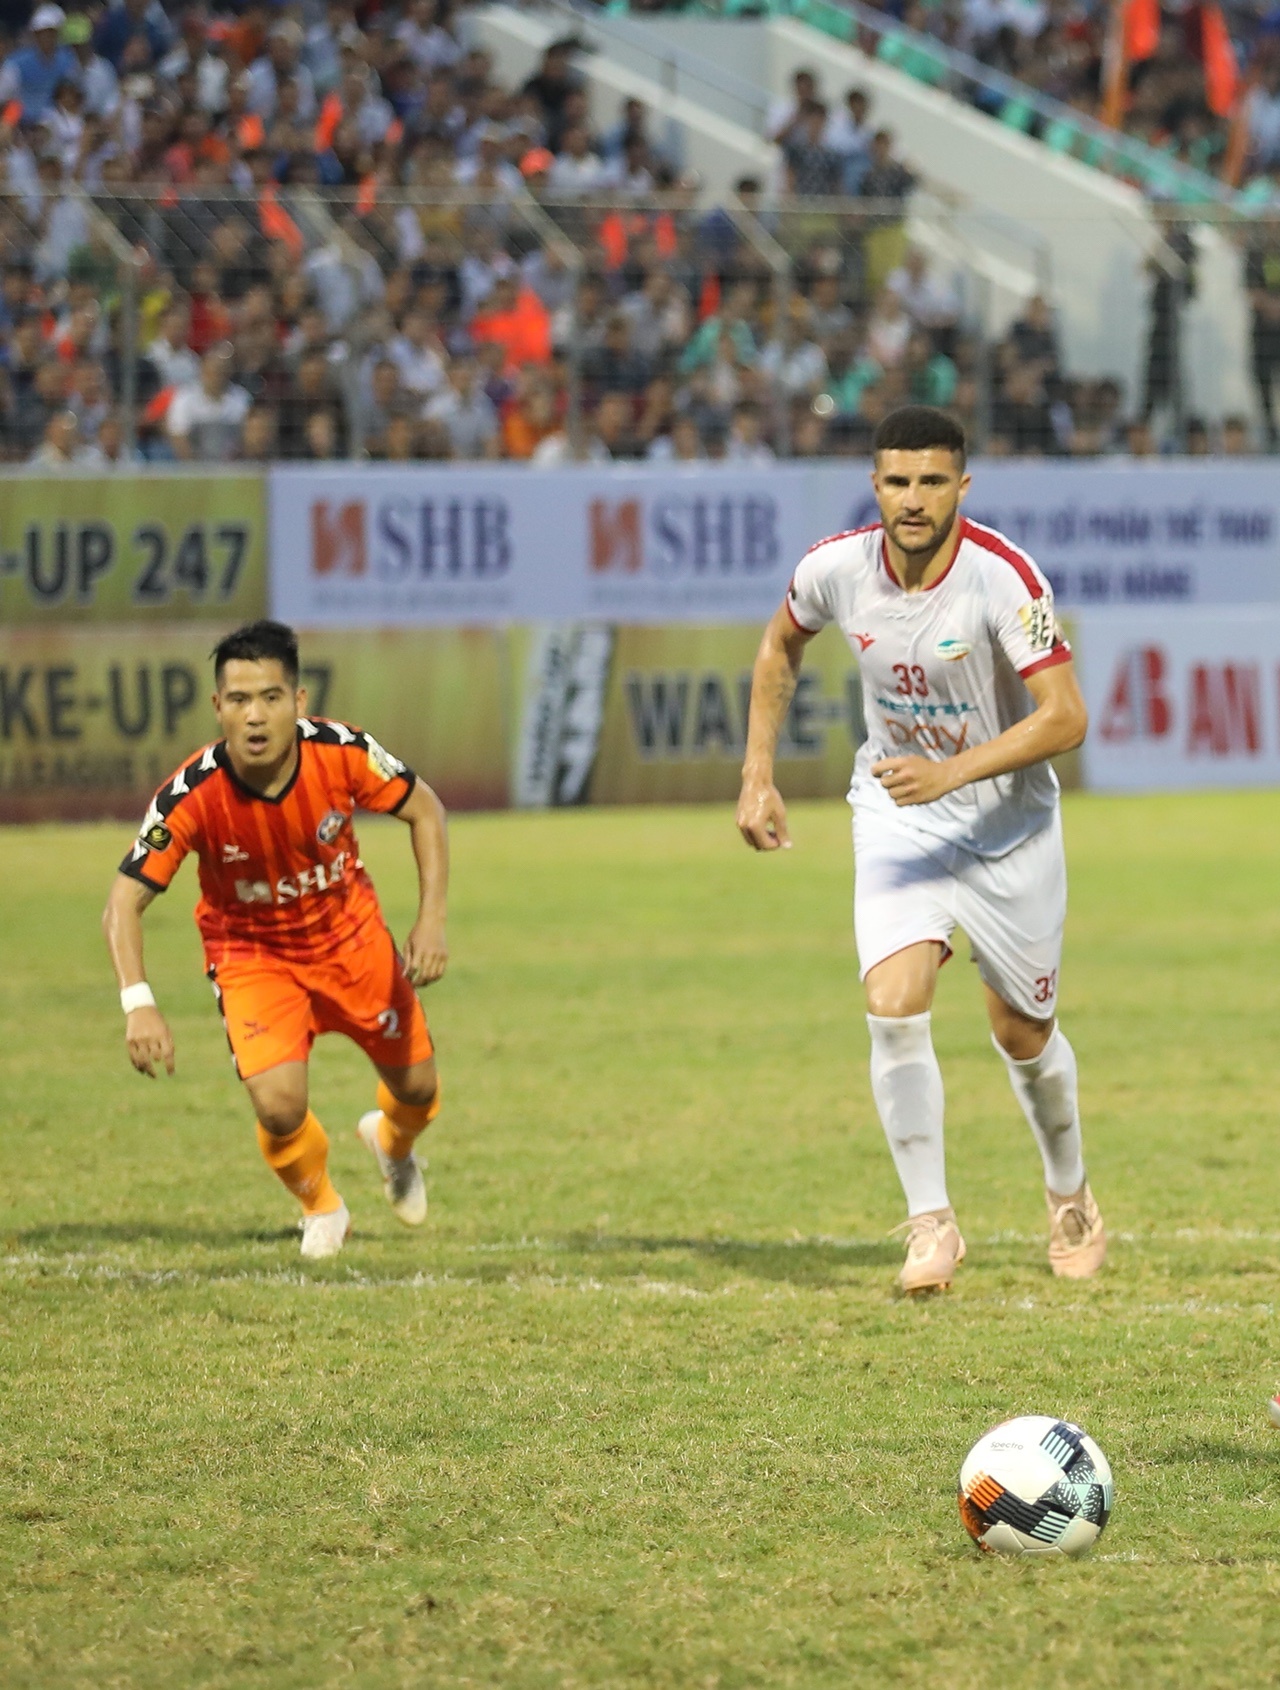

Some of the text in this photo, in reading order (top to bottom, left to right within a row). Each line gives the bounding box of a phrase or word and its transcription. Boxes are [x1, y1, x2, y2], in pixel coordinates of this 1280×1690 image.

[135, 524, 247, 598] 247
[372, 494, 515, 580] SHB
[647, 492, 782, 577] SHB
[892, 664, 930, 698] 33
[1188, 660, 1260, 757] AN
